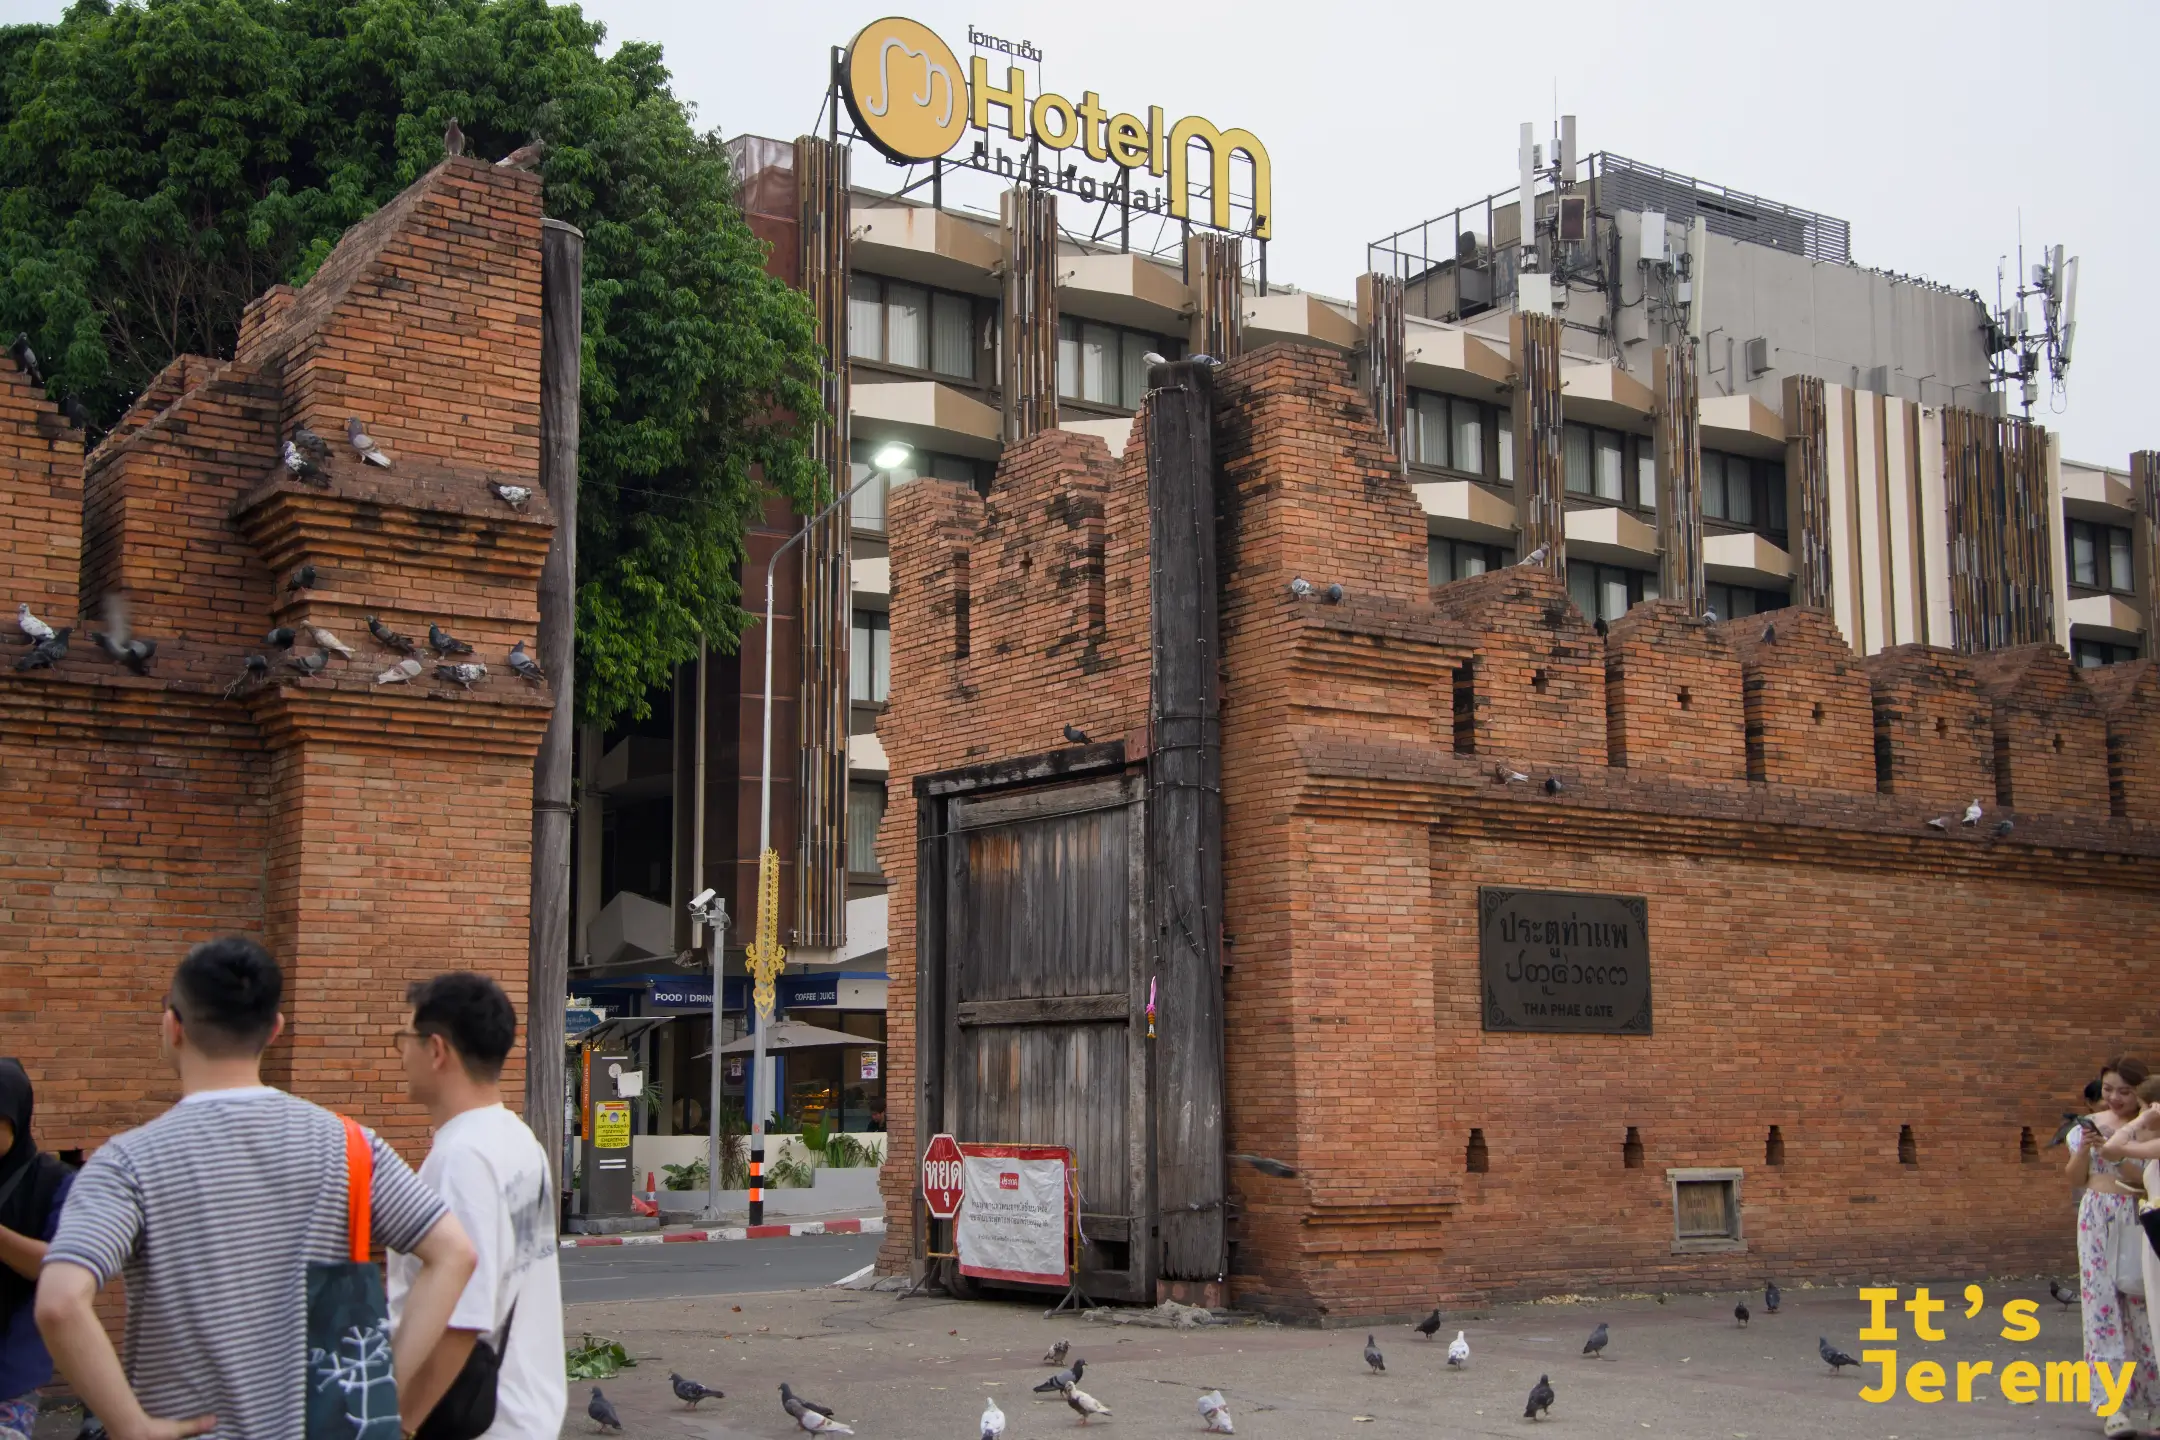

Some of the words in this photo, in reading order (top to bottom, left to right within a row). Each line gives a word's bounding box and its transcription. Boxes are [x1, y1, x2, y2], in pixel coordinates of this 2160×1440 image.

[970, 55, 1164, 178] Hotel
[1500, 911, 1628, 958] ประตูท่าแพ
[655, 993, 683, 1002] FOOD
[689, 994, 714, 1003] DRIN
[795, 993, 816, 1001] COFFEE
[820, 992, 835, 1000] JUICE
[1523, 1003, 1547, 1016] THA
[1551, 1003, 1581, 1017] PHAE
[1585, 1004, 1613, 1018] GATE
[925, 1160, 962, 1208] หยุด
[1001, 1175, 1018, 1187] ประกาศ
